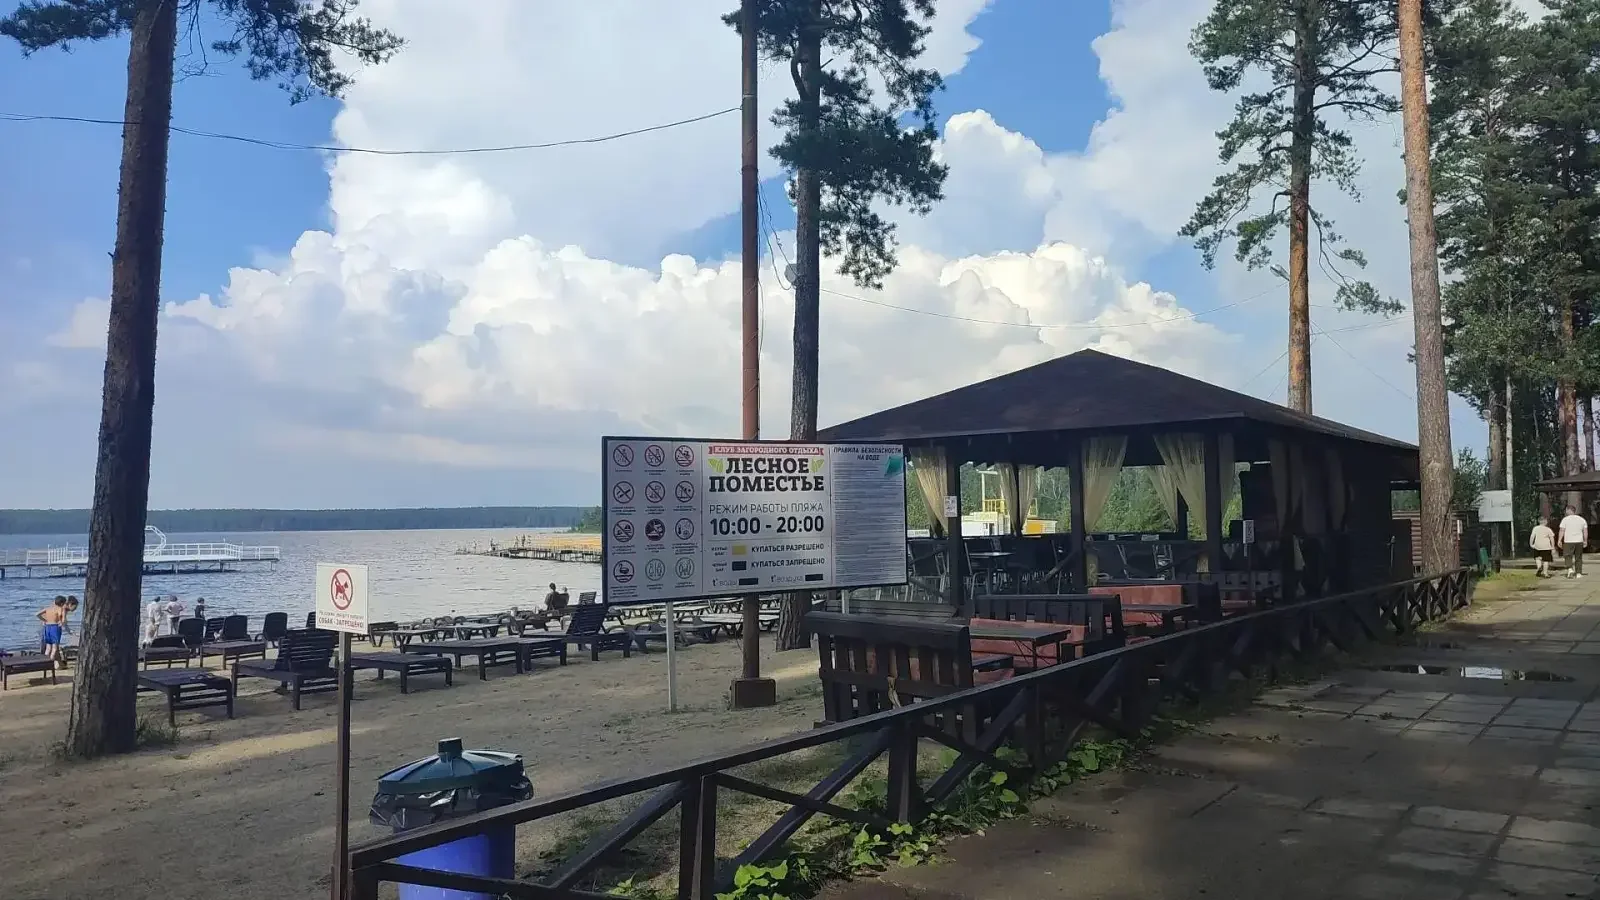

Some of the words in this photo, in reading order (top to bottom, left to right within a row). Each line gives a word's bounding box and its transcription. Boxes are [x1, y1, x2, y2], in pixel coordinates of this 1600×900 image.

[714, 446, 735, 454] КЛУБ
[736, 446, 788, 454] ЗАГОРОДНОГО
[789, 446, 819, 454] ОТДЫХА
[726, 457, 809, 473] ЛЕСНОЕ
[709, 476, 824, 492] ПОМЕСТЬЕ
[709, 504, 748, 514] РЕЖИМ
[750, 503, 789, 514] РАБОТЫ
[791, 503, 824, 513] ПЛЯЖА
[710, 518, 760, 535] 10:00
[776, 515, 824, 533] 20:00
[751, 545, 785, 553] КУПАТЬСЯ
[786, 543, 824, 552] РАЗРЕШЕНО
[751, 560, 785, 568] КУПАТЬСЯ
[785, 558, 825, 567] ЗАПРЕЩЕНО
